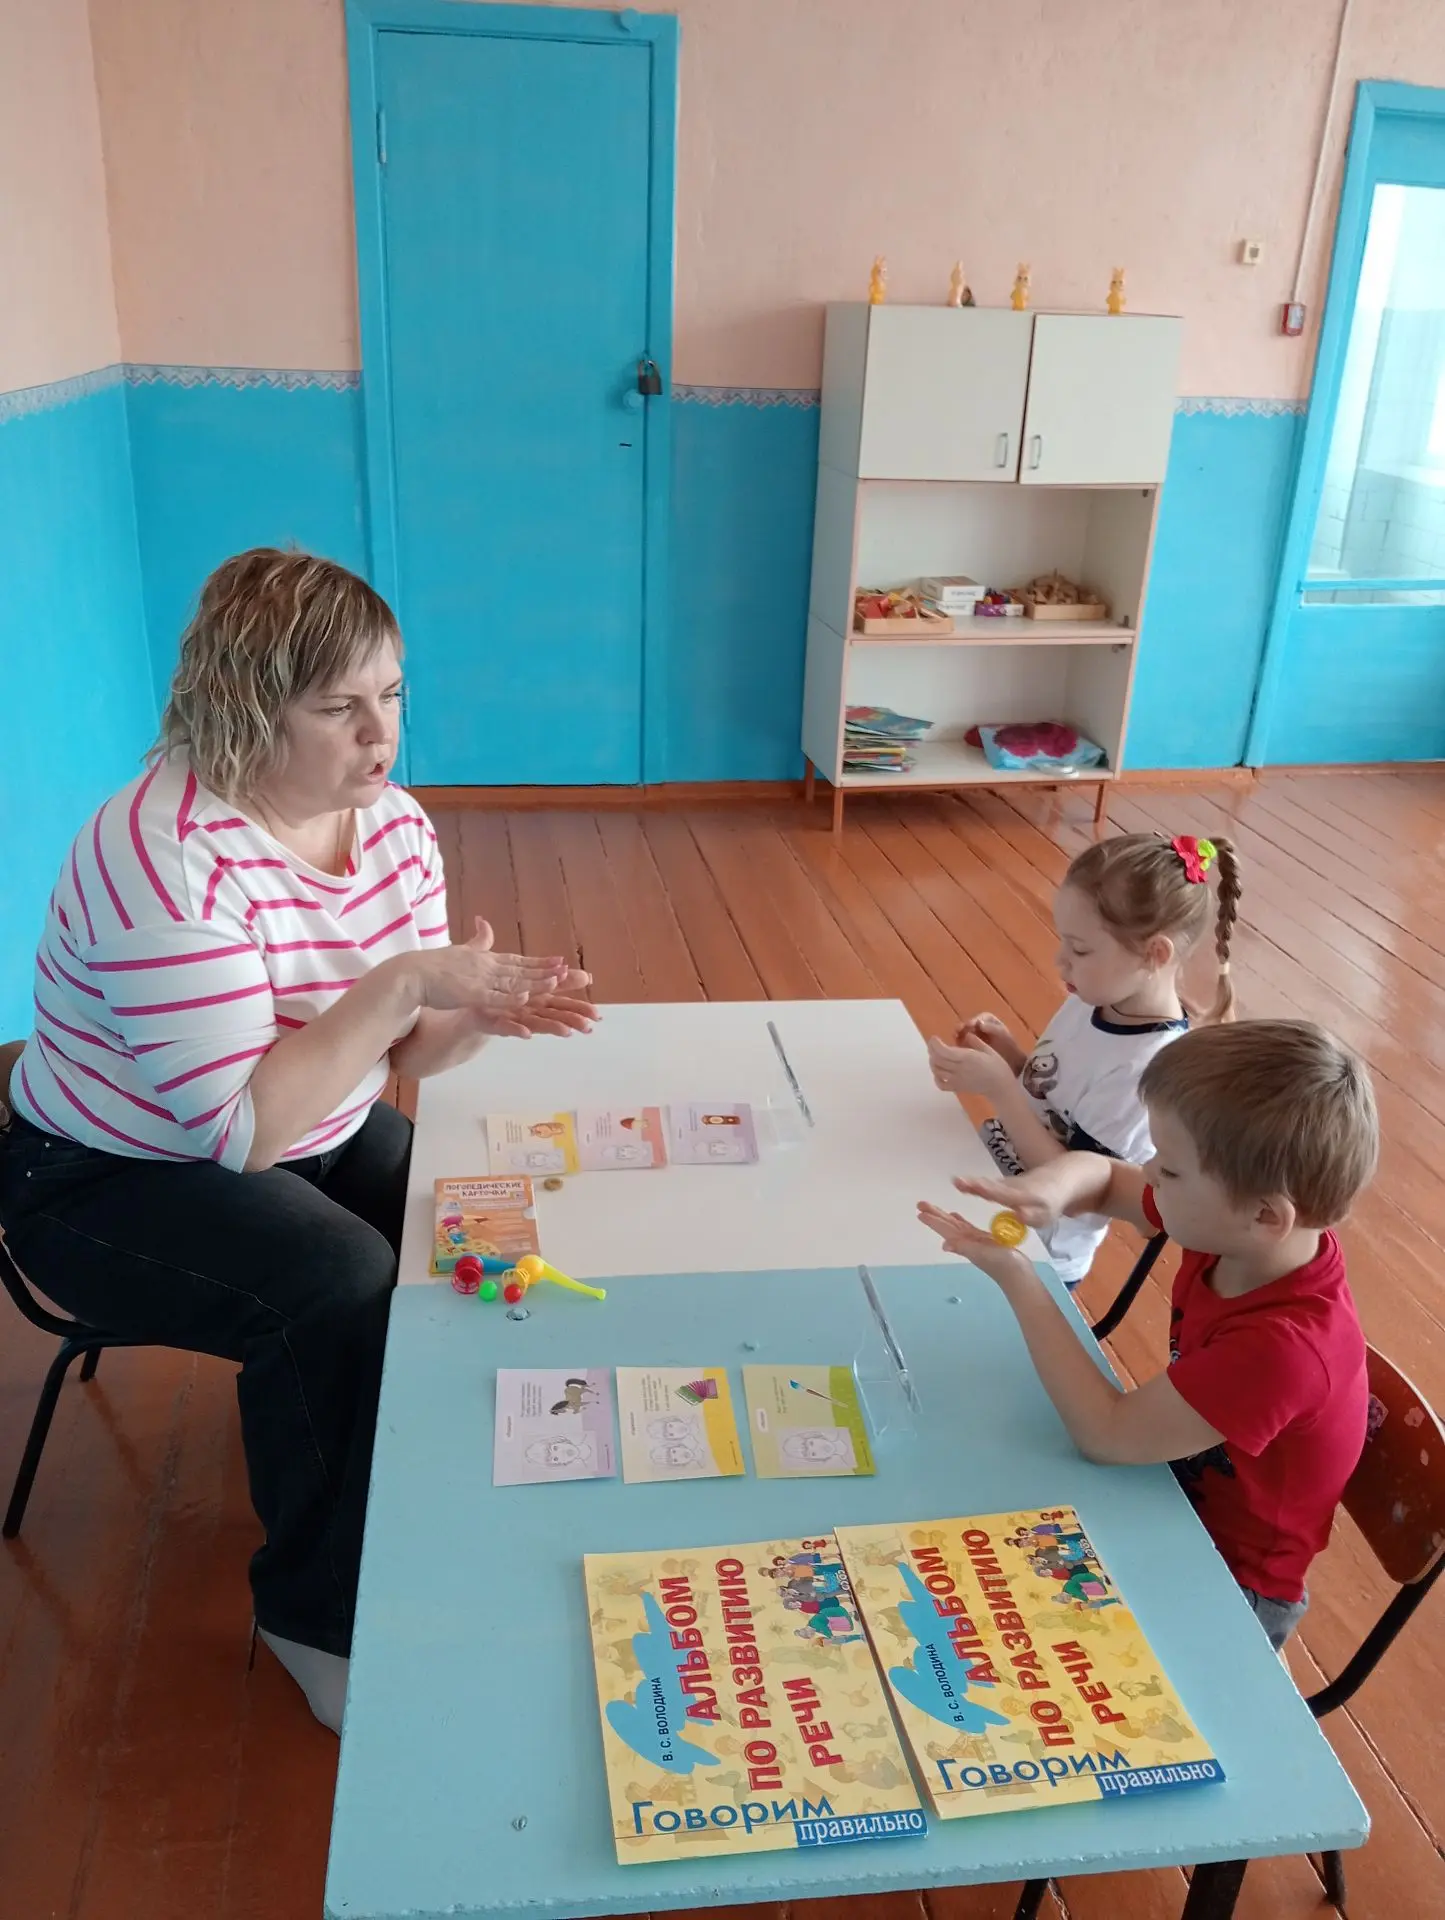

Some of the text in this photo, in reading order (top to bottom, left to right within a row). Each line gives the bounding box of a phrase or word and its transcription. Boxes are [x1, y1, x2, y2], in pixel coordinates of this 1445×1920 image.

[659, 1576, 722, 1721] АЛЬБОМ
[910, 1547, 1002, 1683] АЛЬБОМ
[961, 1529, 1075, 1747] ПО РАЗВИТИЮ
[651, 1676, 670, 1735] ВОЛОДИНА
[715, 1558, 783, 1791] ПО РАЗВИТИЮ
[926, 1643, 954, 1698] ВОЛОДИНА
[1051, 1640, 1127, 1725] РЕЧИ
[782, 1677, 843, 1768] РЕЧИ
[936, 1749, 1131, 1790] Говорим
[1101, 1762, 1216, 1793] правильно
[632, 1795, 835, 1834] Говорим
[800, 1811, 923, 1844] правильно
